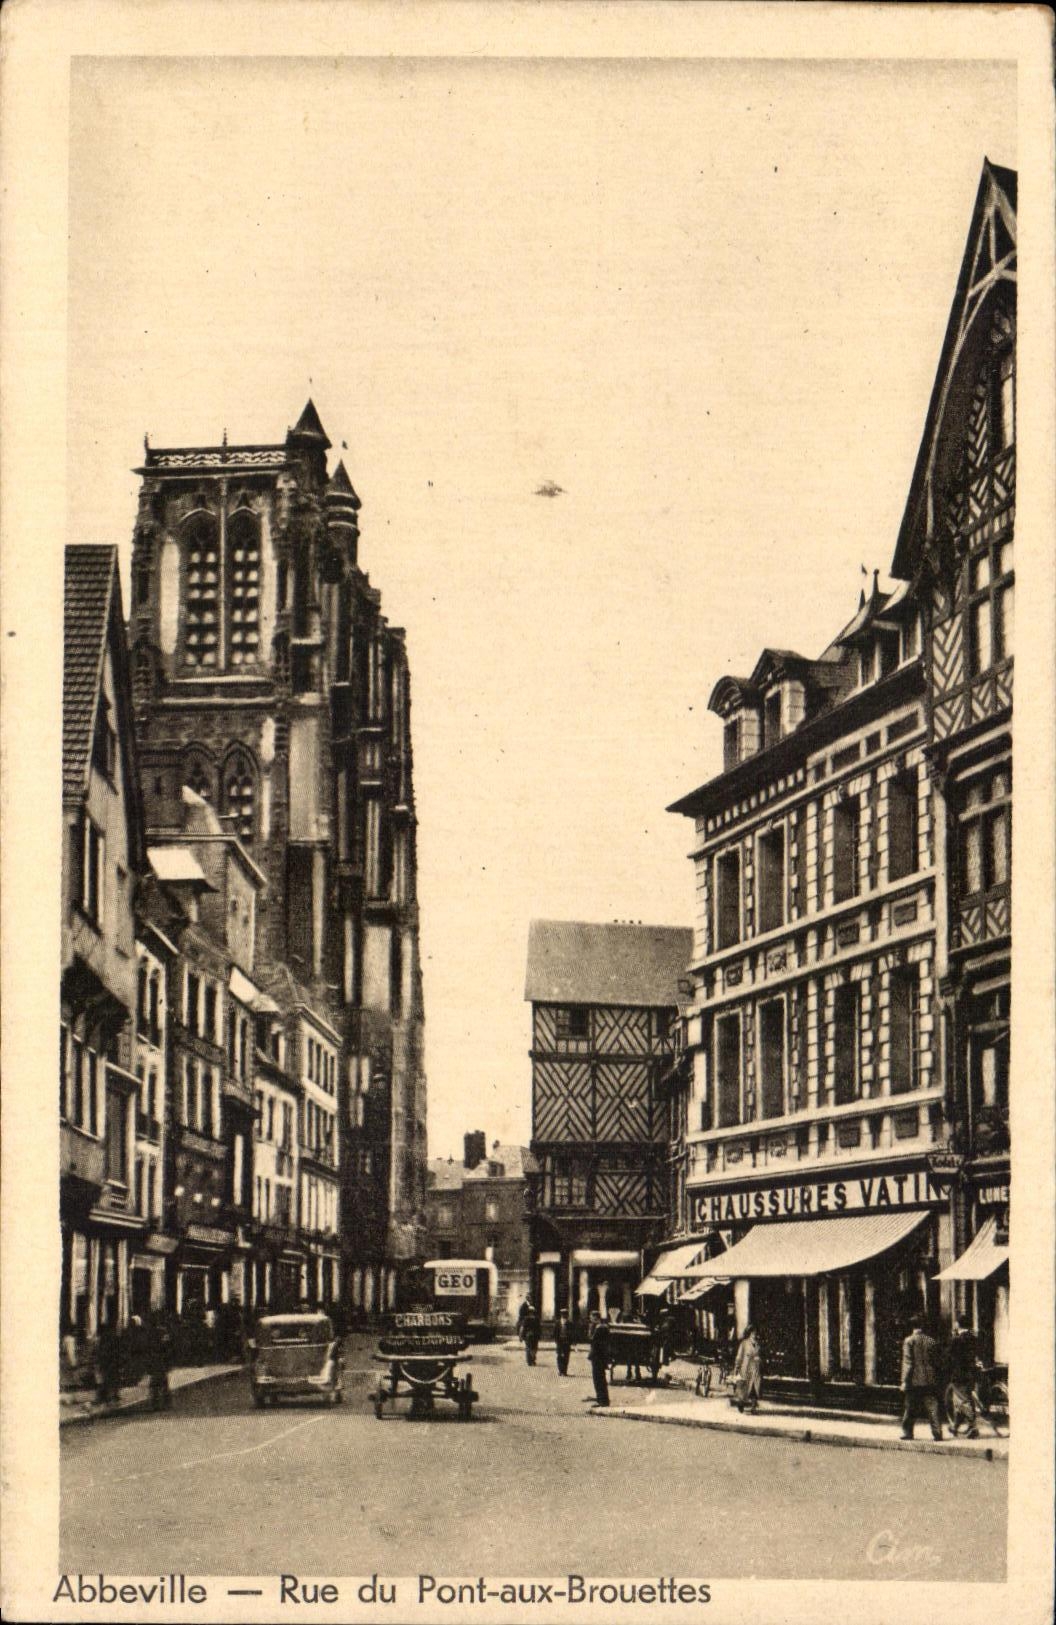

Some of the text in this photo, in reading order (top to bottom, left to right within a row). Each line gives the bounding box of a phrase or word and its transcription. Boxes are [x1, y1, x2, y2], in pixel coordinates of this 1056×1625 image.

[697, 1171, 942, 1221] CHAUSSURES VATIN
[437, 1274, 474, 1289] GEO
[394, 1313, 453, 1328] CHARBONS
